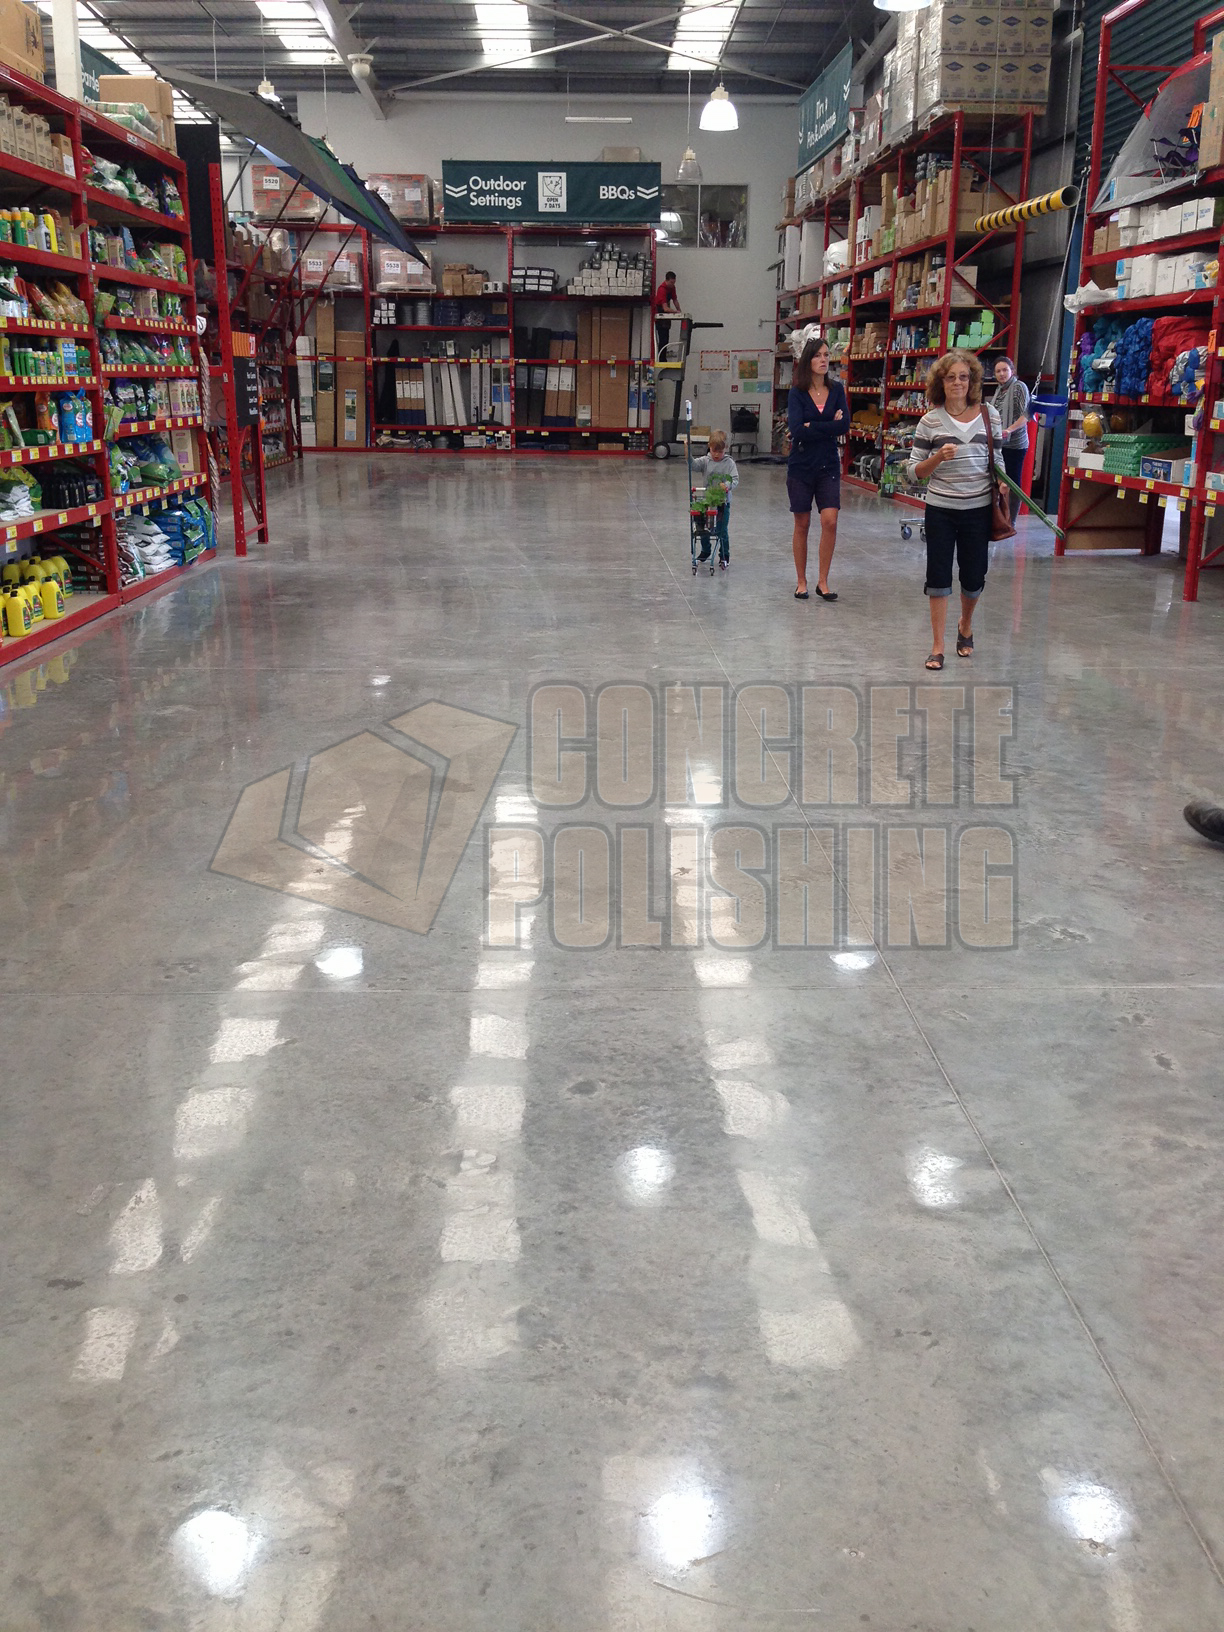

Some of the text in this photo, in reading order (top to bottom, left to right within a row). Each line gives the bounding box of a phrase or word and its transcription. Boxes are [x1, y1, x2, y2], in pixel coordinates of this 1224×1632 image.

[469, 175, 527, 191] Outdoor
[469, 192, 522, 209] Settings
[600, 185, 635, 200] BBQs
